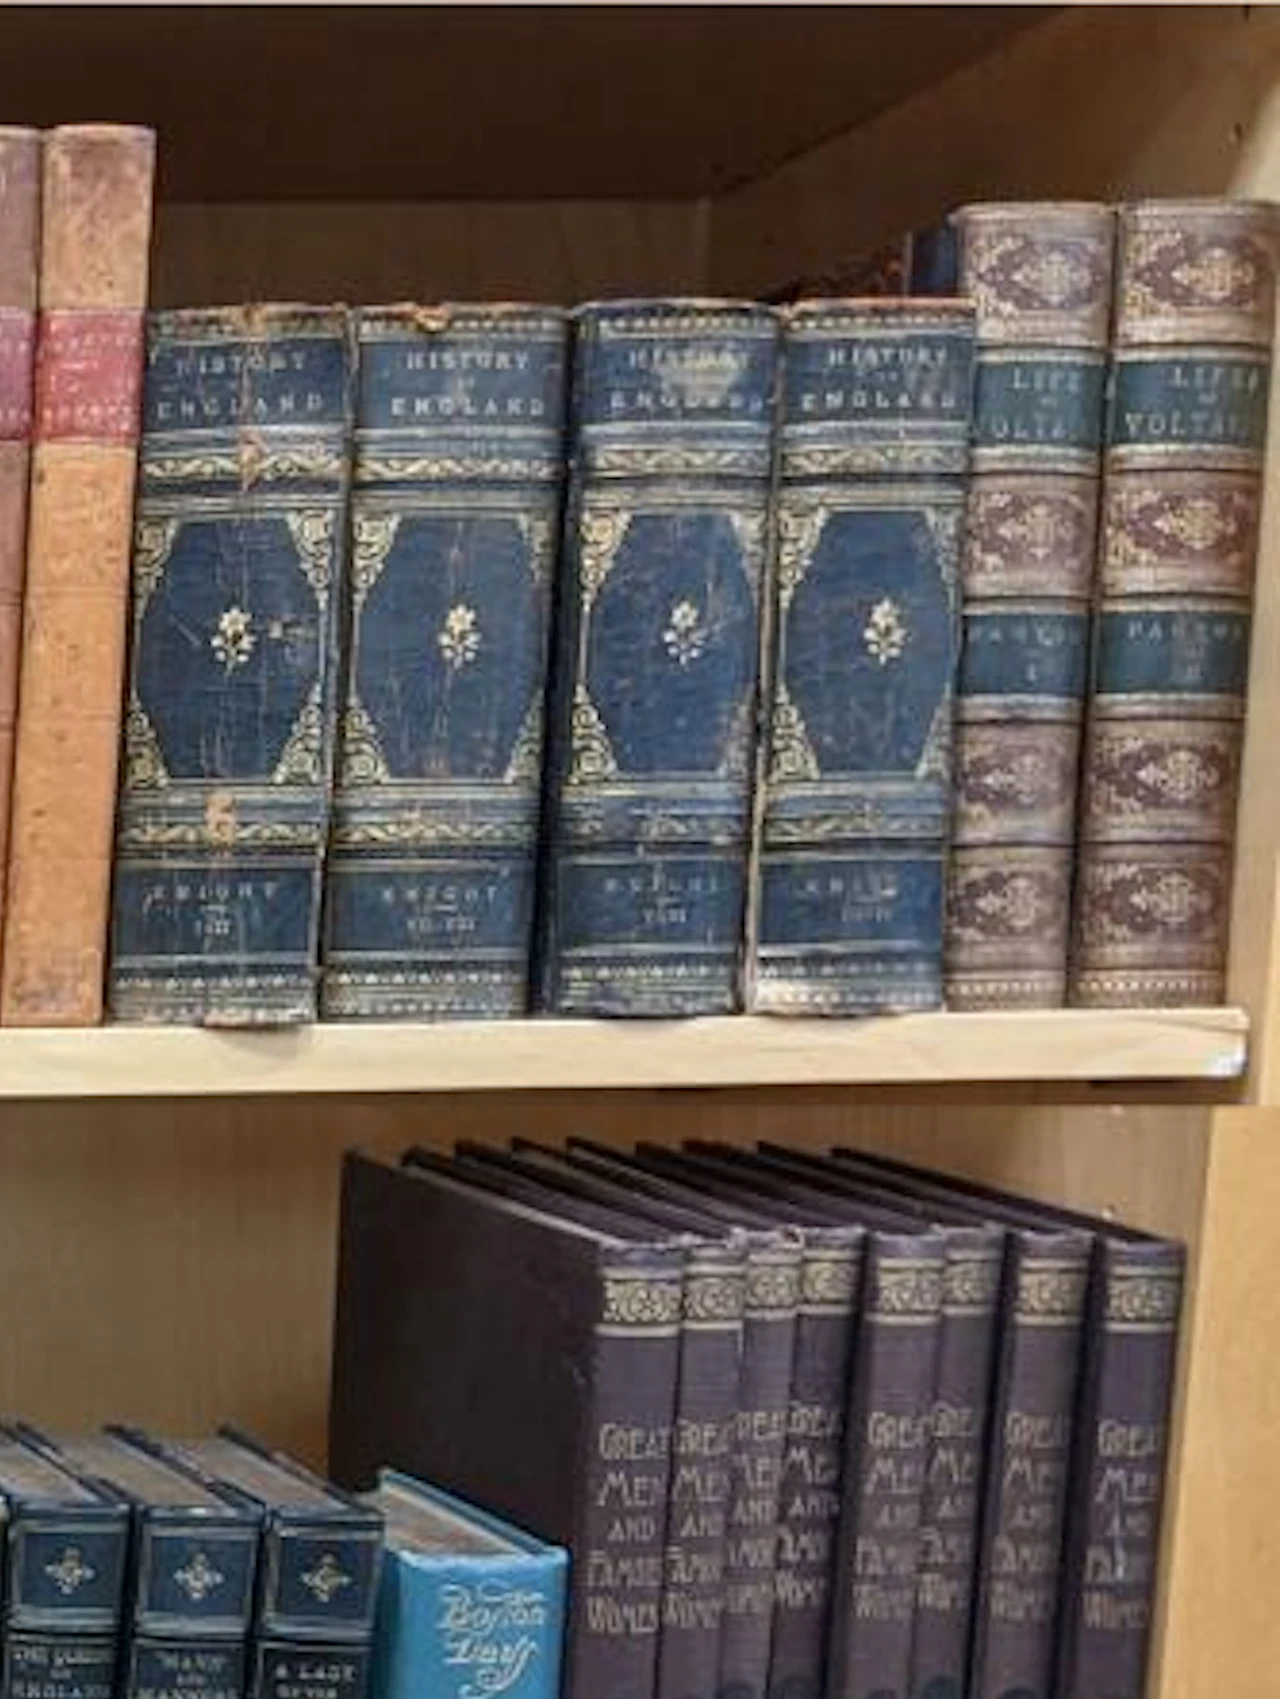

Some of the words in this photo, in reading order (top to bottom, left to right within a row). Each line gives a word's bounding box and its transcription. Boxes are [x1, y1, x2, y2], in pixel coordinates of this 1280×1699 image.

[175, 349, 308, 376] HISTORY
[405, 349, 531, 371] HISTORY
[828, 346, 949, 366] HISTORY
[1012, 367, 1083, 391] LIFE
[157, 393, 324, 421] ENGLAND
[390, 396, 547, 417] ENGLAND
[598, 1421, 672, 1461] GREAT
[596, 1470, 667, 1508] MEN
[606, 1516, 657, 1542] AND
